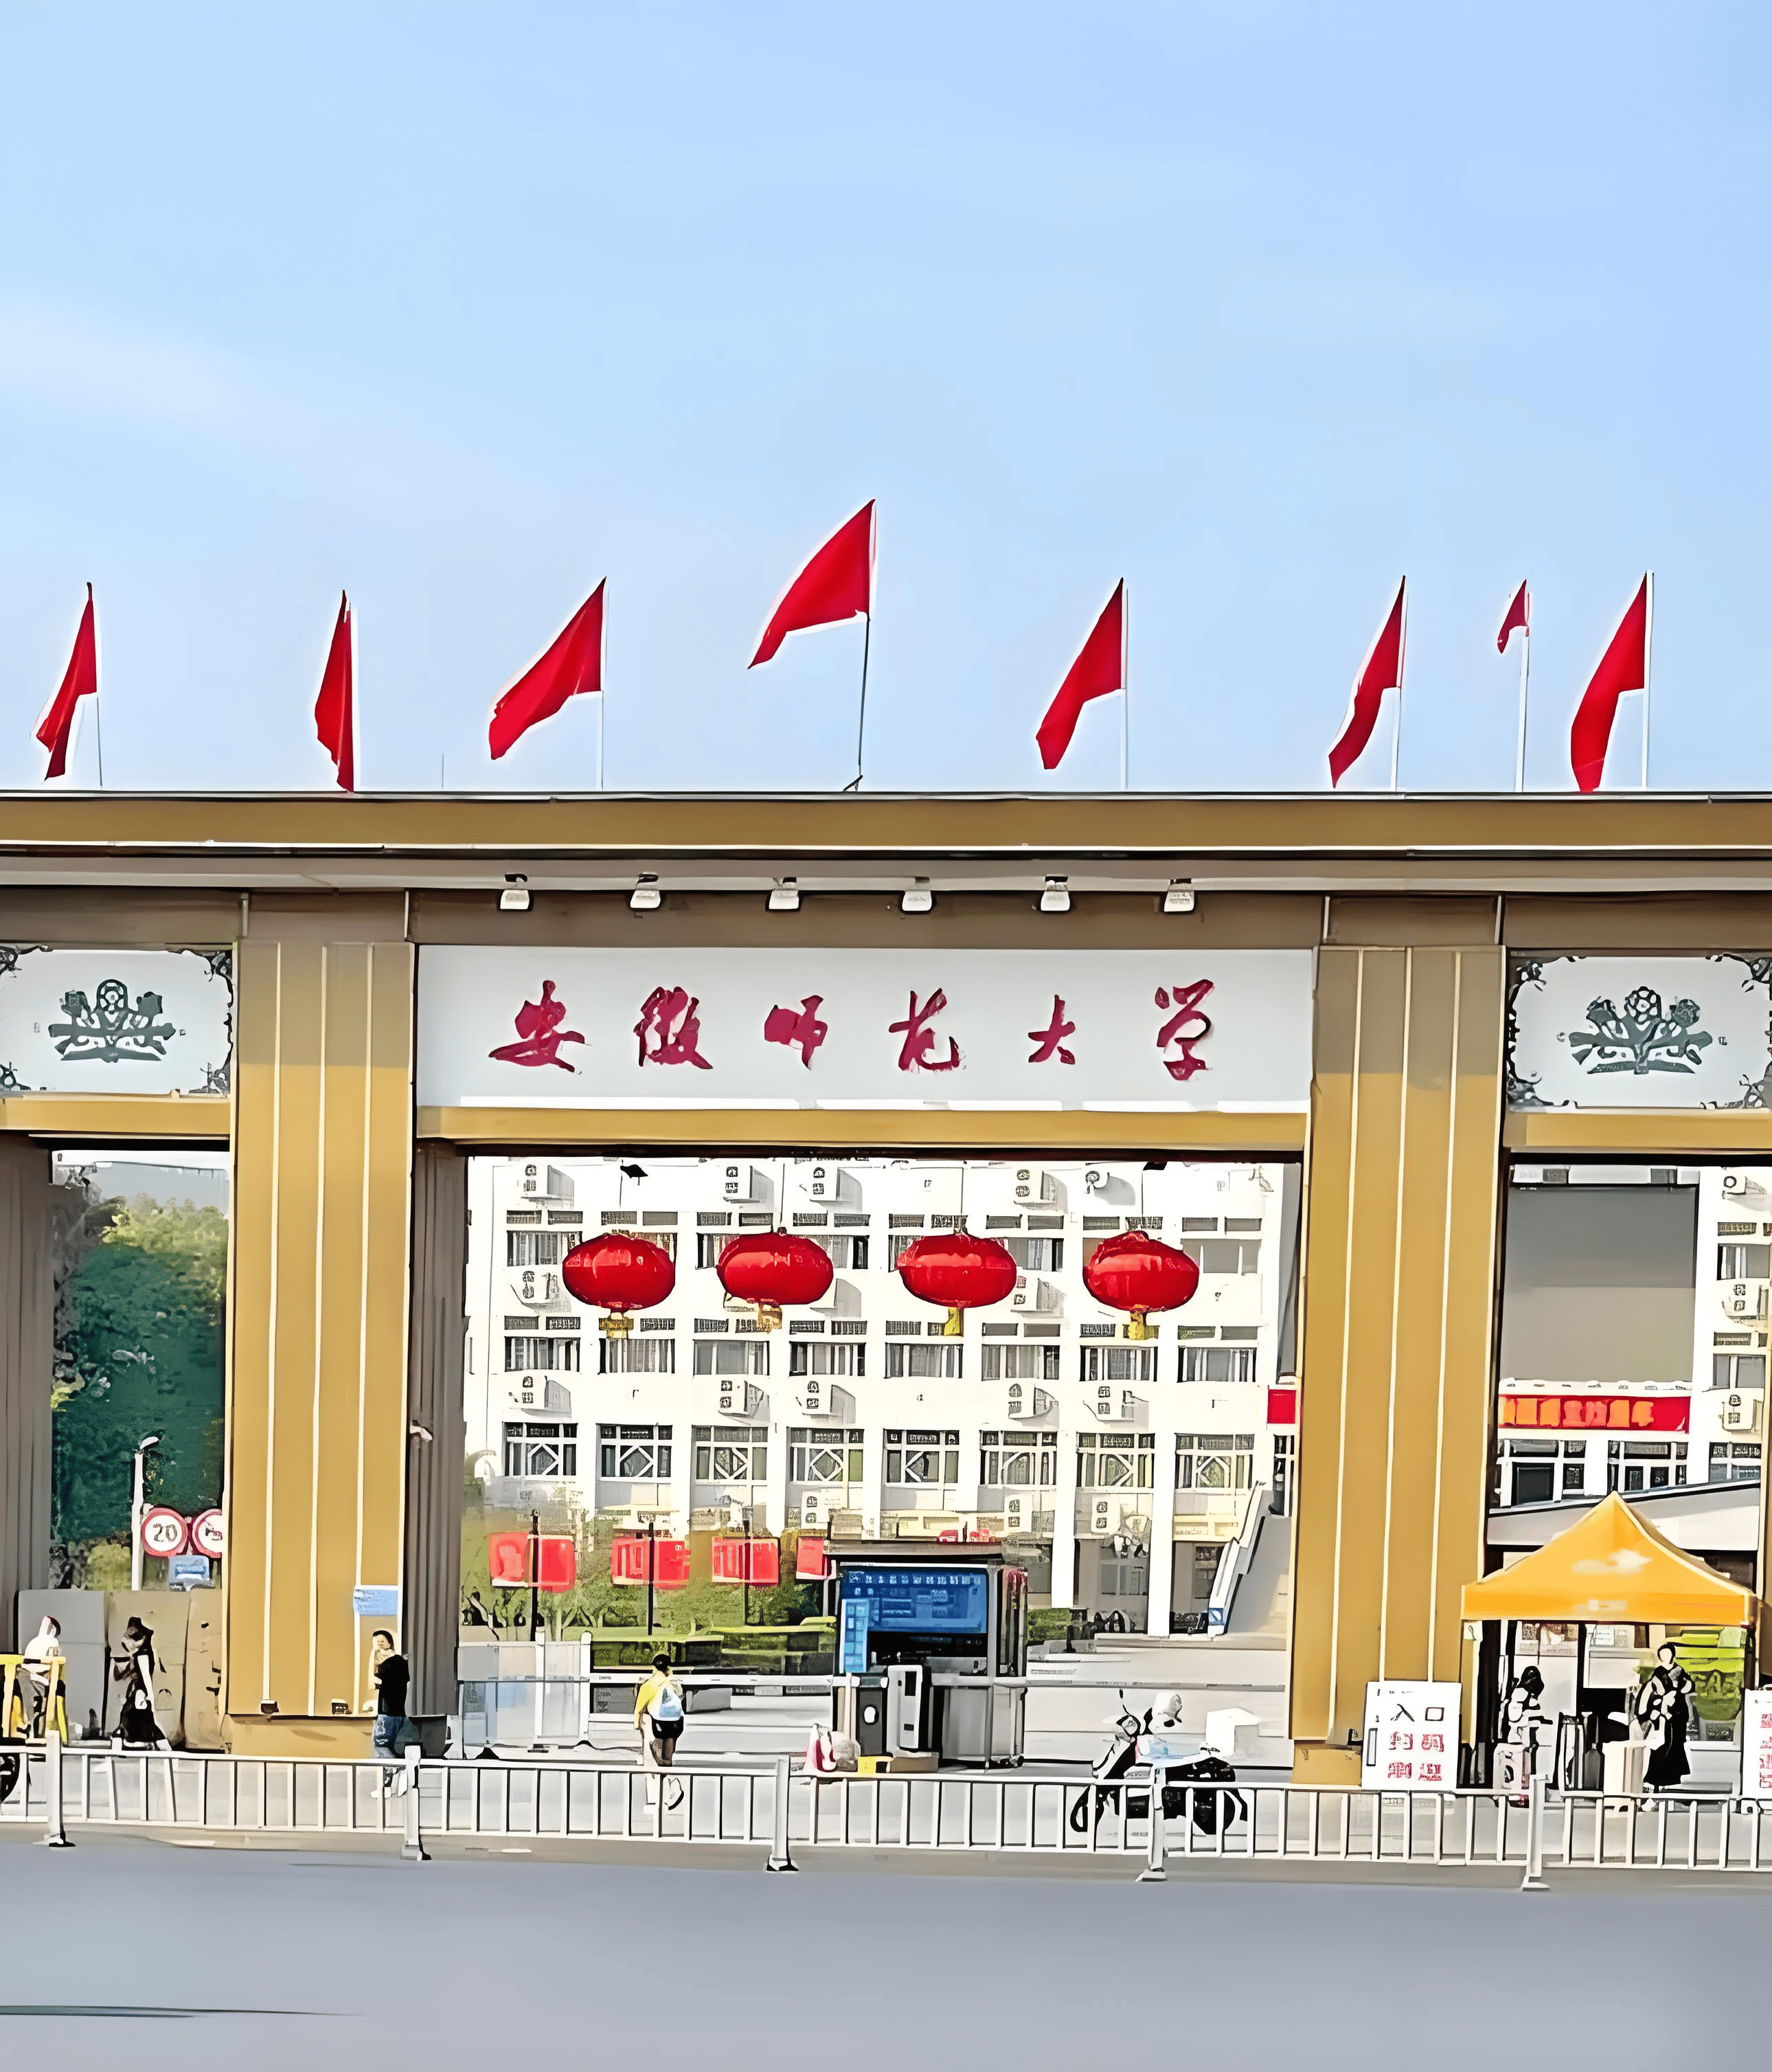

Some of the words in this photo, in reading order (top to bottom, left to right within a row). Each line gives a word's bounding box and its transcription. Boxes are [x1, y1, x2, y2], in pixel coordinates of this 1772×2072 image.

[487, 979, 1216, 1082] 安徽师范大学
[152, 1523, 178, 1542] 20
[1390, 1703, 1445, 1722] 入口
